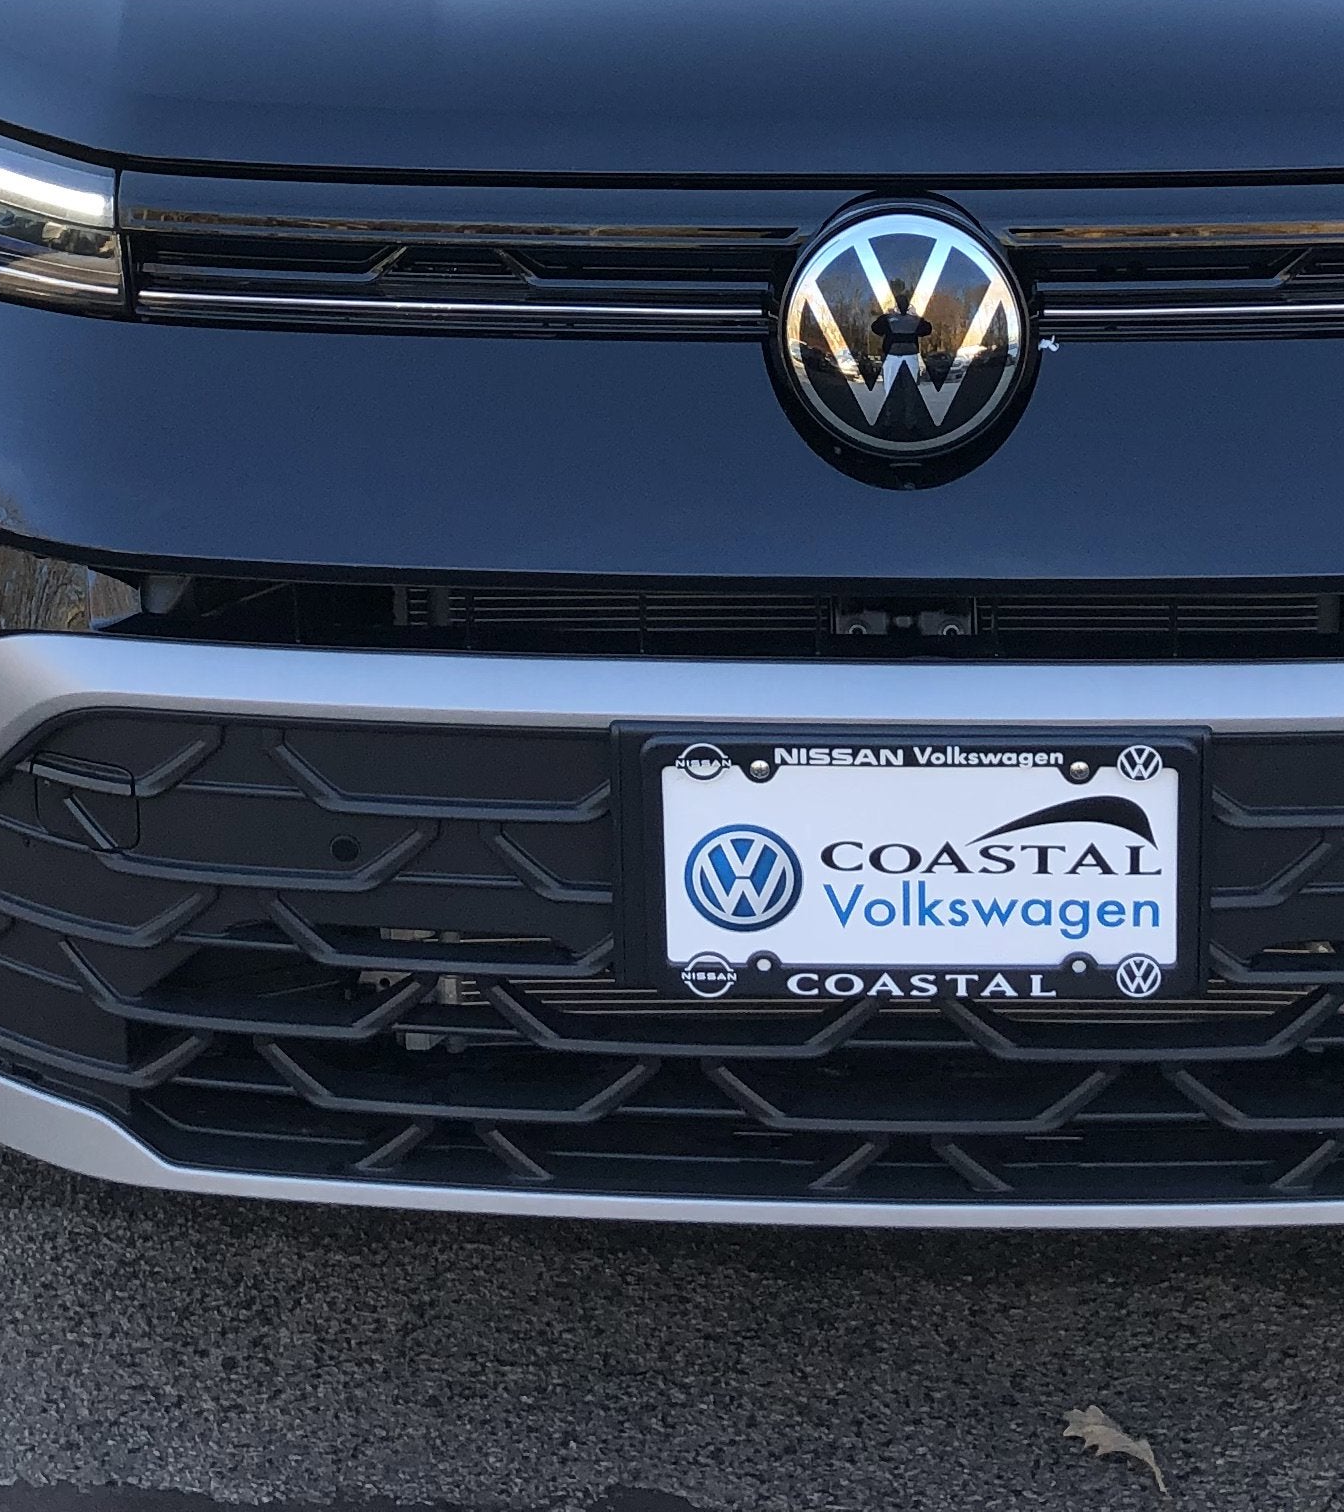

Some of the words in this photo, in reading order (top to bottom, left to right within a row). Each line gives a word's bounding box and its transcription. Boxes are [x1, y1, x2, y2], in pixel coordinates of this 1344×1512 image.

[675, 758, 732, 769] NISSAN
[774, 747, 904, 766] NISSAN
[913, 746, 1064, 769] Volkswagen
[820, 840, 1162, 876] COASTAL
[822, 880, 1160, 940] Volkswagen
[681, 971, 737, 981] NISSAN
[786, 972, 1057, 998] COASTAL
